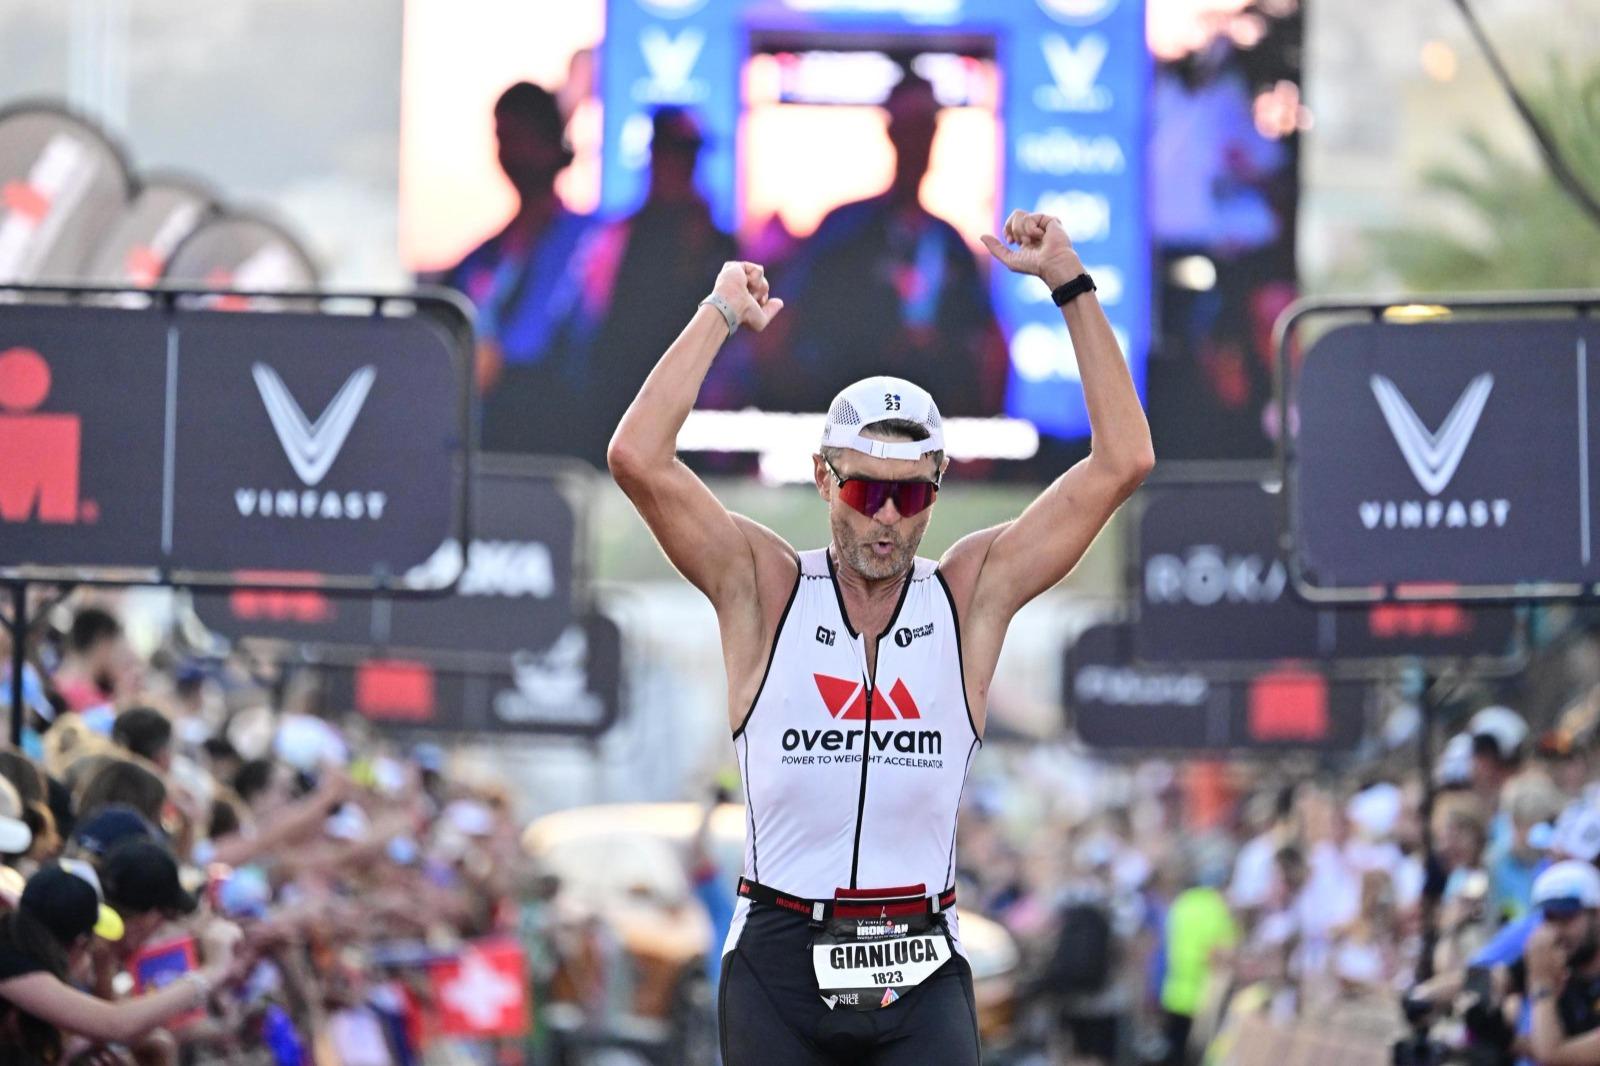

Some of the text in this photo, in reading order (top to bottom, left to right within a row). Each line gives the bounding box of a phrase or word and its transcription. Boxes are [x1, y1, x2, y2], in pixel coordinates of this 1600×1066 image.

[885, 402, 901, 411] 23
[234, 488, 386, 519] VINFAST
[1358, 499, 1511, 529] VINFAST
[782, 728, 942, 755] overvam
[782, 754, 944, 769] POWER TO WEIGHT ACCELERATOR
[830, 938, 939, 970] GIANLUCA
[872, 970, 904, 985] 1823
[839, 997, 860, 1005] NICE
